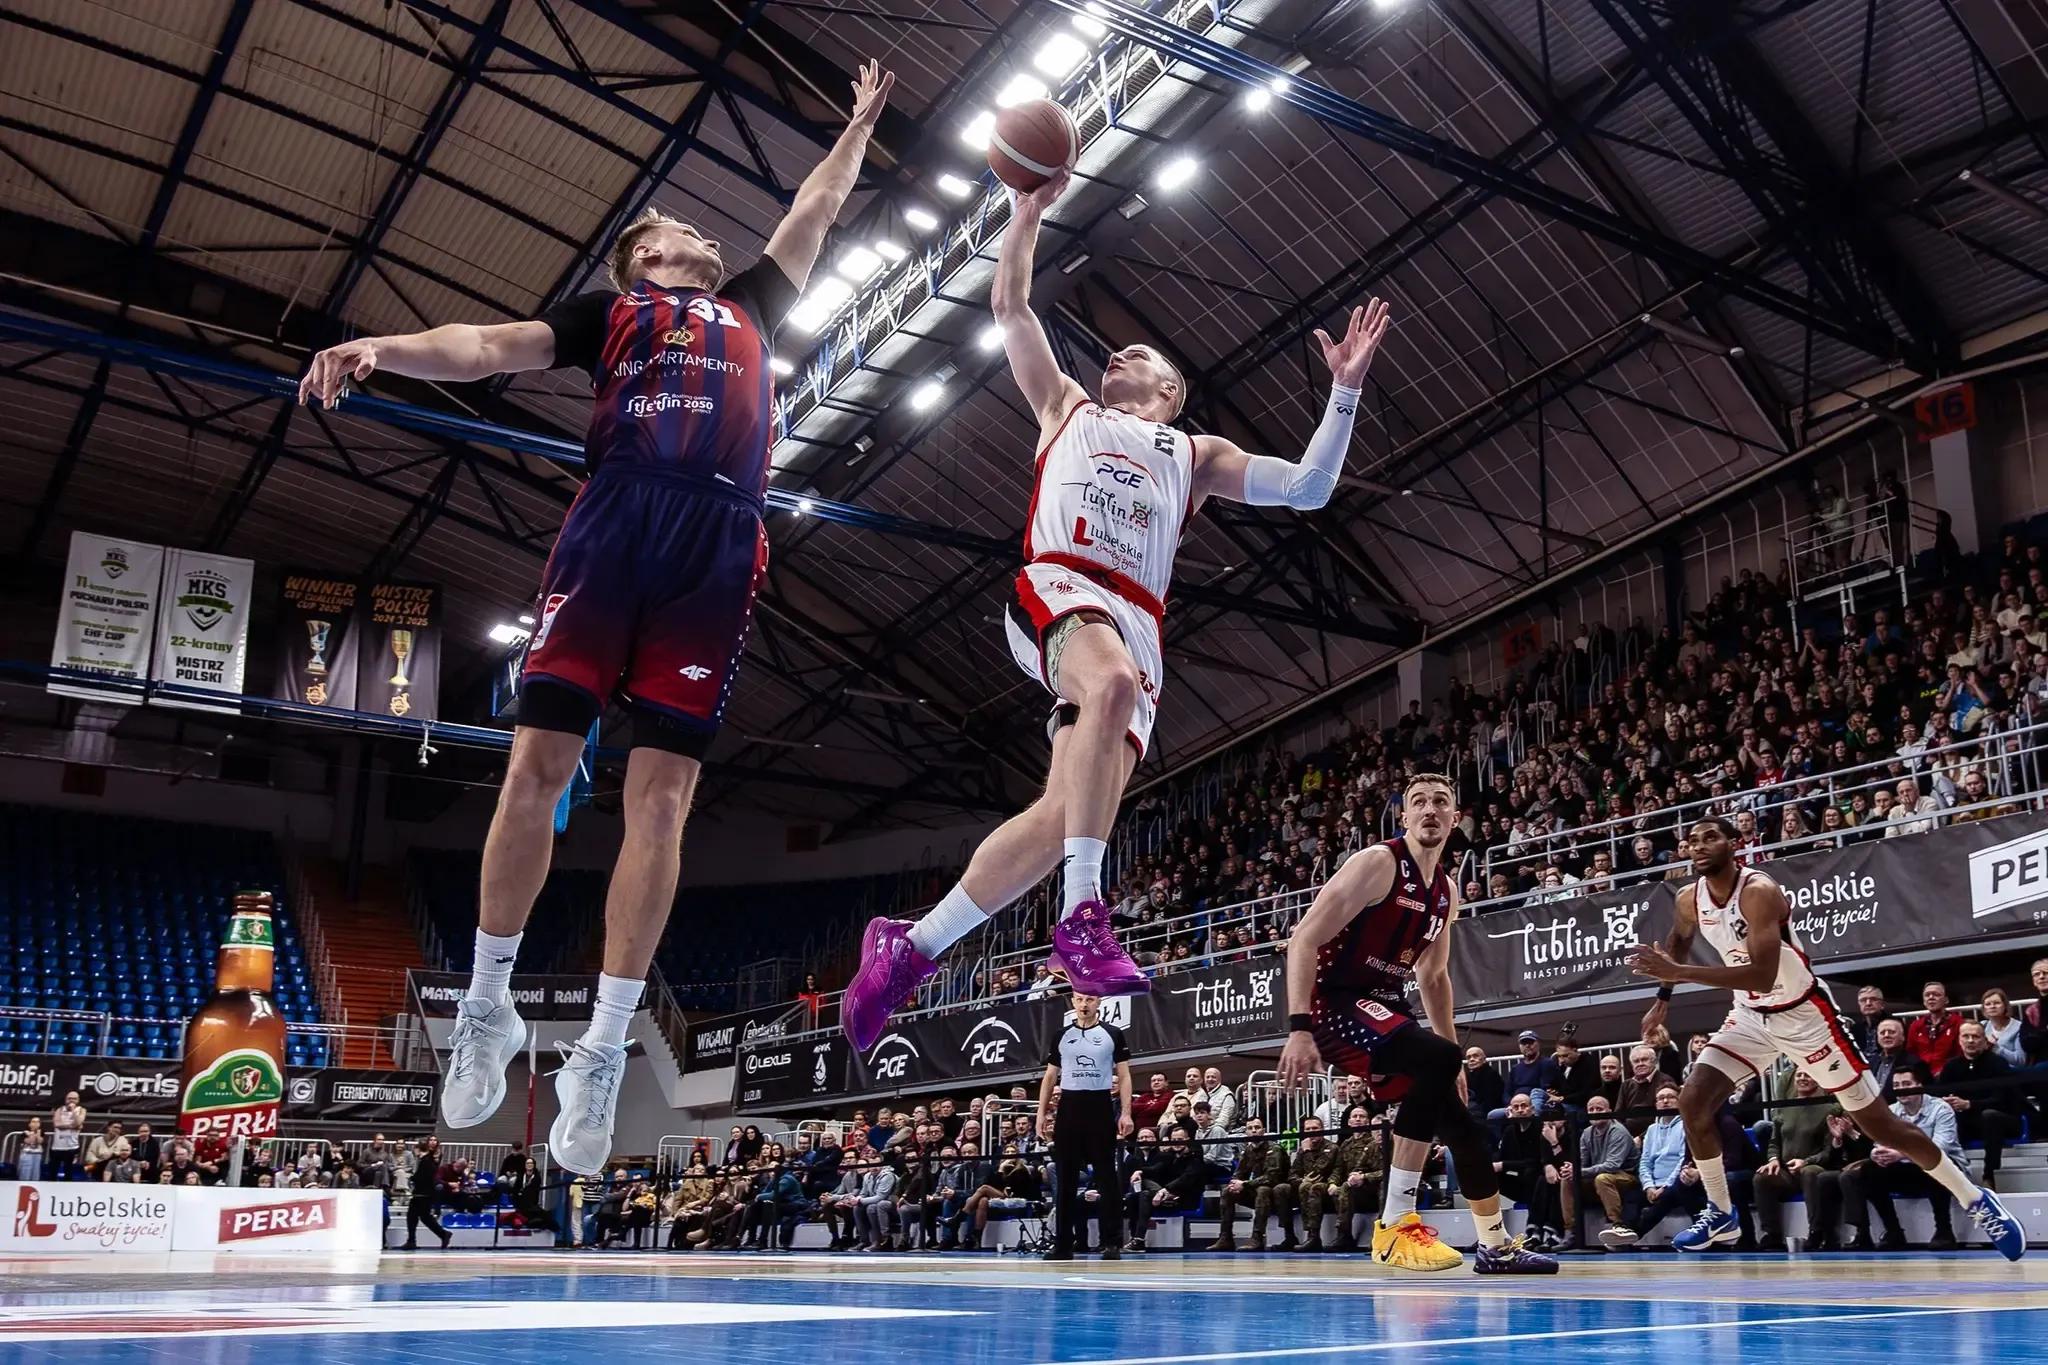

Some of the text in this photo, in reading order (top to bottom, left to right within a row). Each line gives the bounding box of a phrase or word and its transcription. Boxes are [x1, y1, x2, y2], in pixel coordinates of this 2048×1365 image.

[687, 298, 741, 328] 31
[614, 350, 744, 377] ING ARTAMENTY
[684, 399, 714, 411] 2050
[1096, 463, 1145, 489] PGE
[188, 579, 227, 598] MKS
[285, 576, 356, 597] WINNER
[371, 583, 433, 601] MISTRZ
[373, 598, 430, 616] POLSKI
[170, 636, 233, 654] 22-krotny
[176, 656, 224, 671] MISTRZ
[679, 664, 712, 681] 4F
[176, 668, 223, 683] POLSKI
[1400, 859, 1410, 878] C
[1991, 846, 2048, 894] PE
[1780, 871, 1876, 909] belskie
[1832, 901, 1879, 937] życie!
[1365, 955, 1386, 971] KING
[1523, 966, 1567, 980] MIASTO
[1195, 1011, 1273, 1030] MIASTO INSPIRACJI
[759, 1053, 791, 1068] LEXUS
[970, 1039, 1008, 1066] PGE
[876, 1054, 908, 1080] PGE
[338, 1085, 408, 1101] FERMENTOWNIA
[191, 1108, 277, 1141] PERŁA
[50, 1196, 166, 1218] lubelskie
[233, 1204, 325, 1234] PERŁA
[63, 1222, 168, 1247] Smakuj życie!
